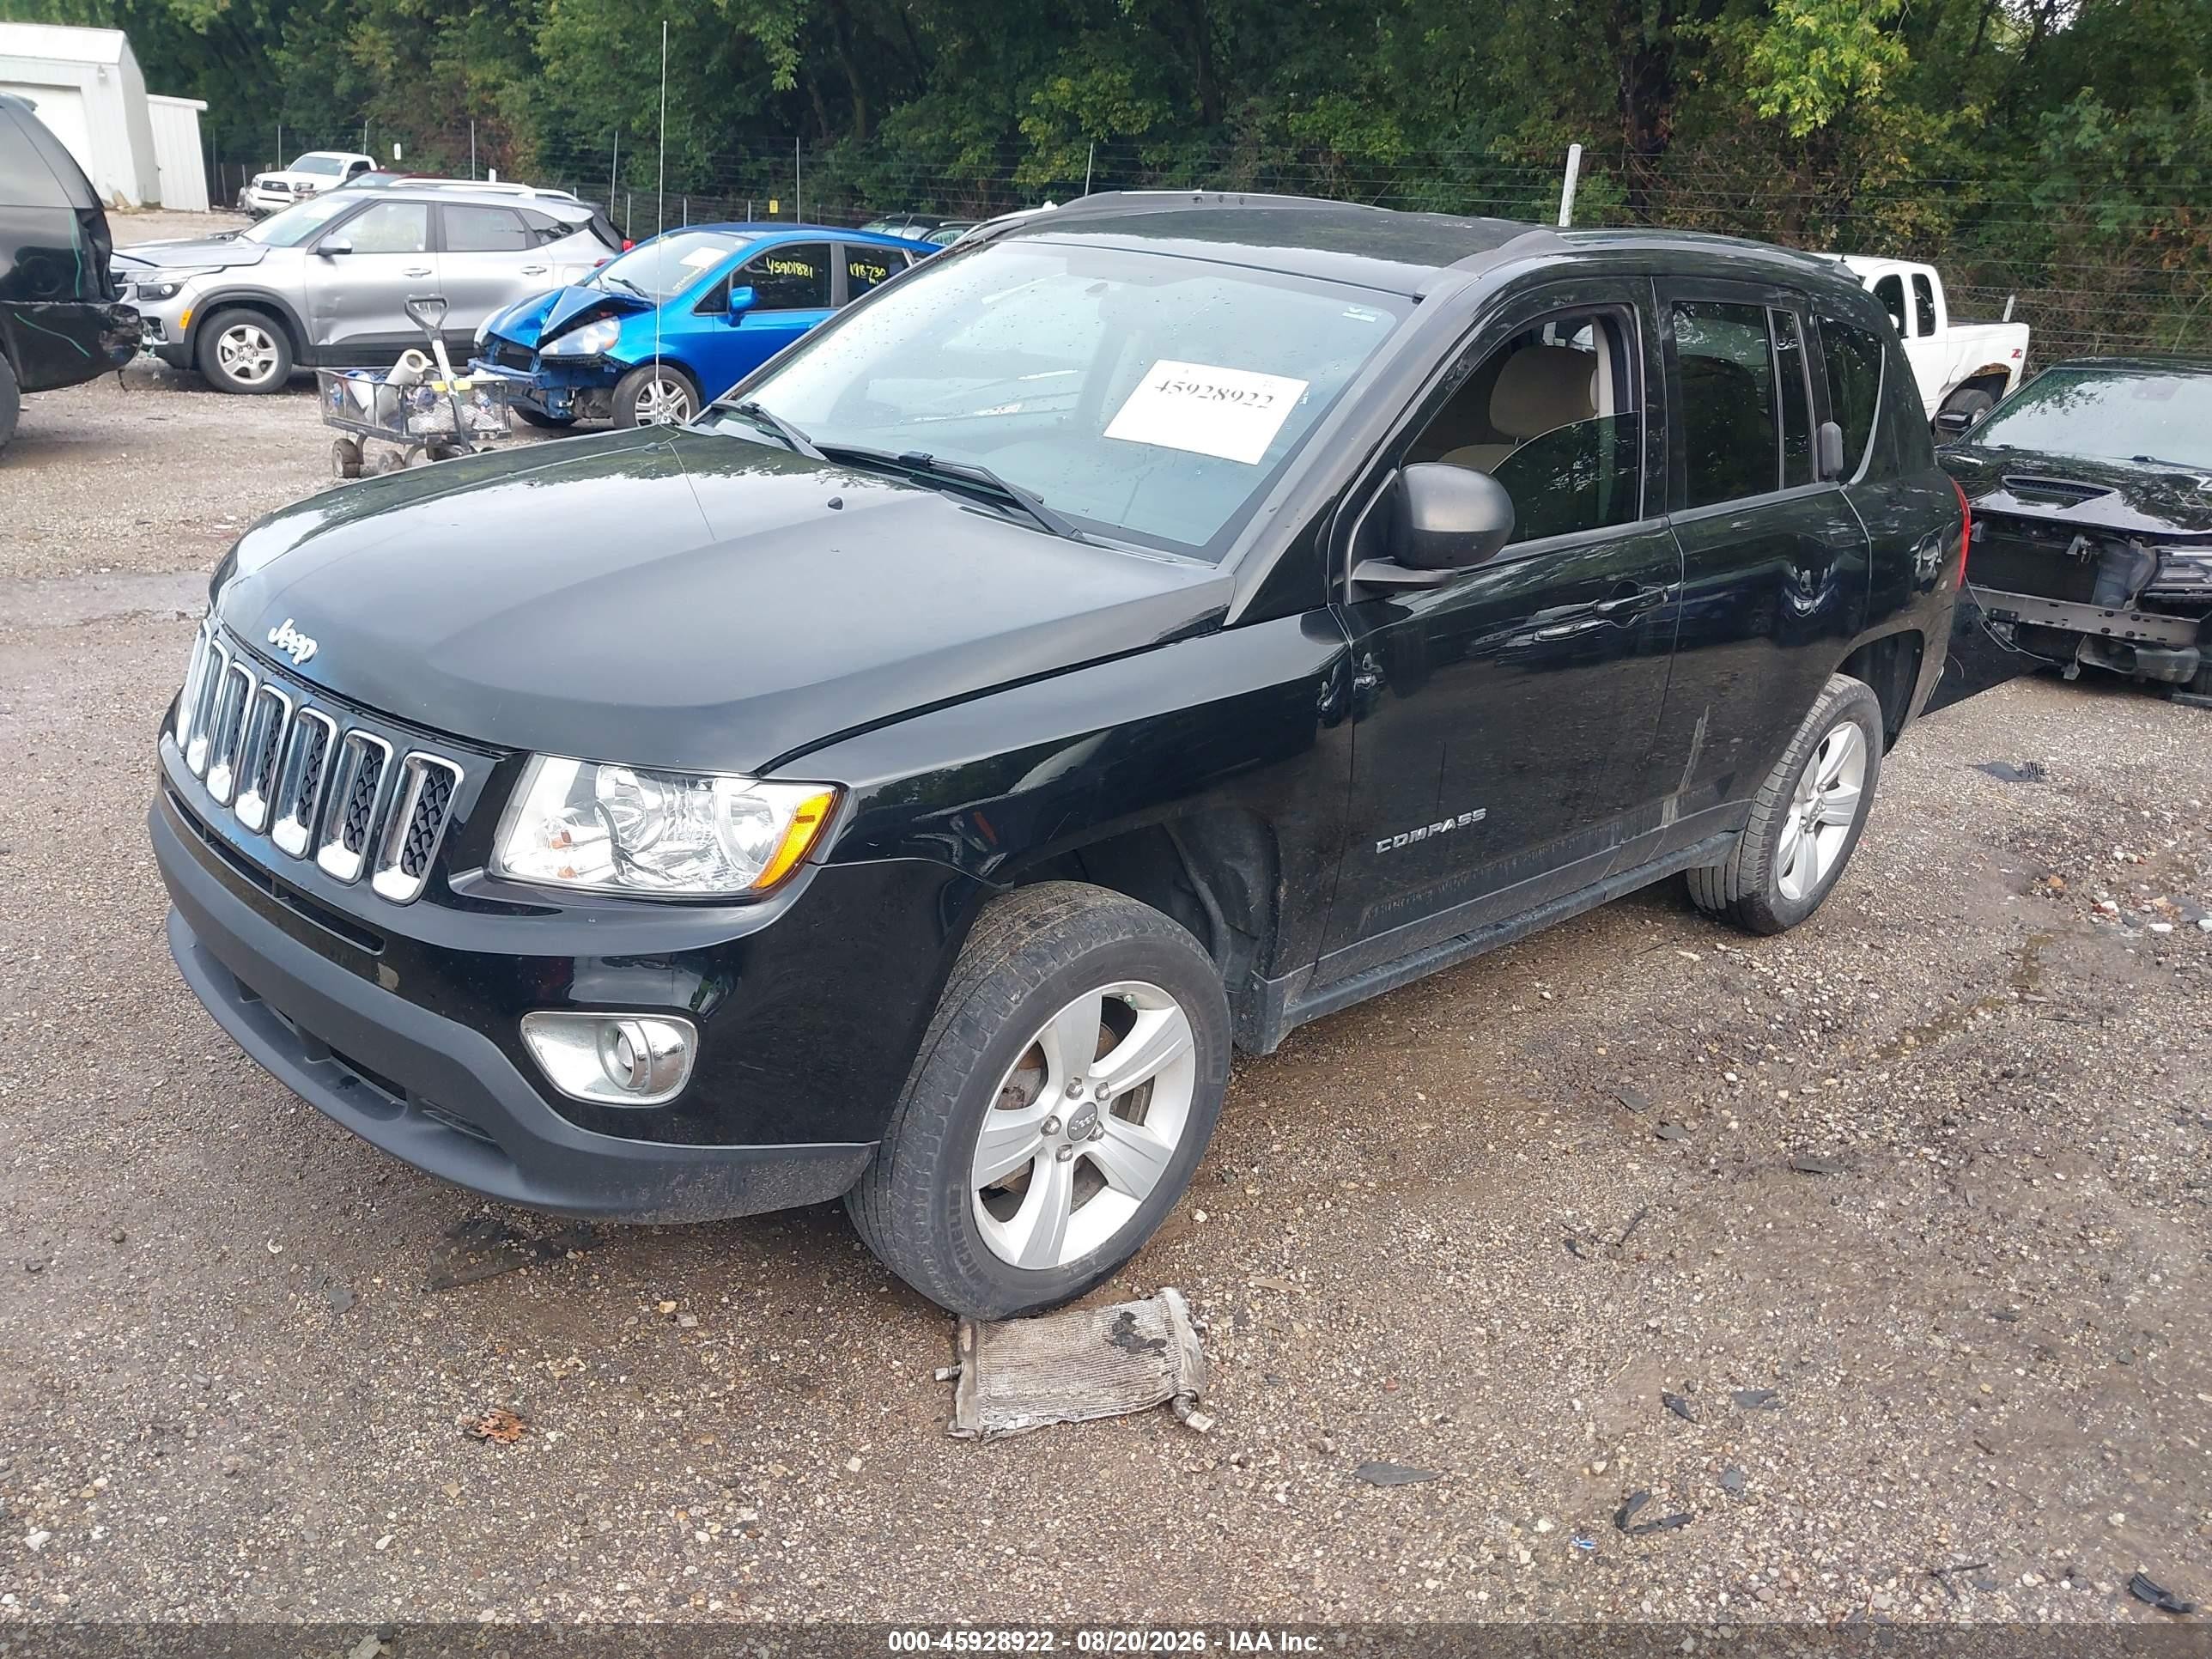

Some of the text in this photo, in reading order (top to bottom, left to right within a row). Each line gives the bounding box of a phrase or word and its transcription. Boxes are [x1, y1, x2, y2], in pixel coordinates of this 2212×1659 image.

[1154, 380, 1274, 409] 45928922
[267, 617, 319, 665] Jeep
[1376, 807, 1488, 854] COMPASS
